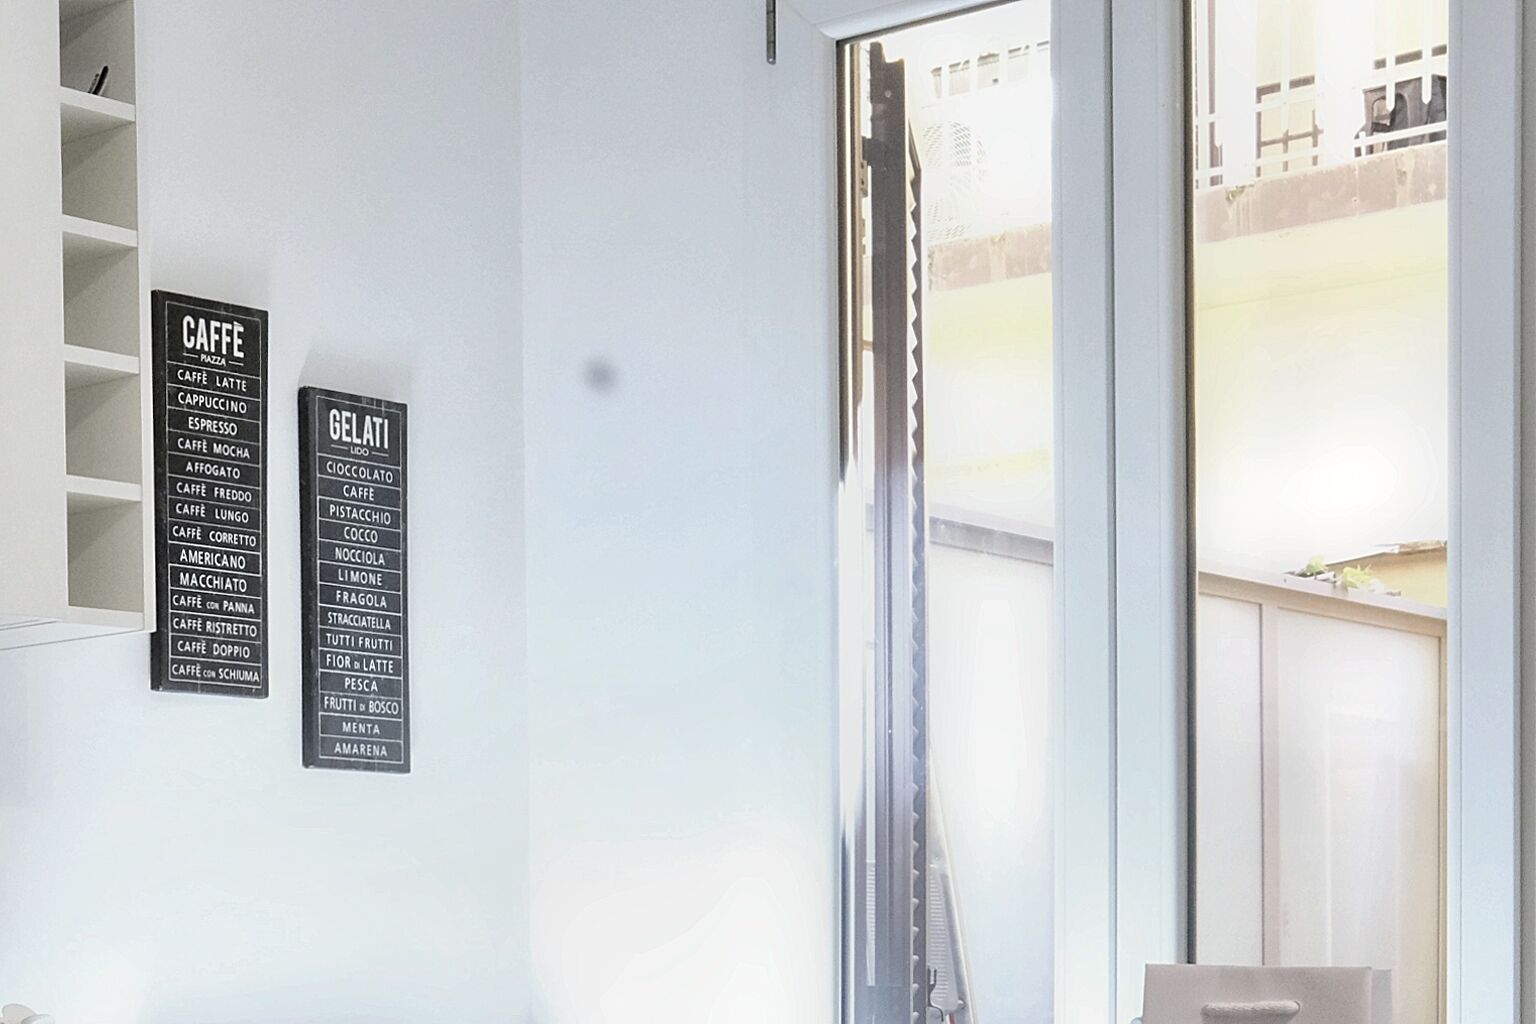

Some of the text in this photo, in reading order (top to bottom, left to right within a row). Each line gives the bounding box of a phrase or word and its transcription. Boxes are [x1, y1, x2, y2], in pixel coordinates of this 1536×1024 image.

[182, 315, 244, 358] CAFFÈ
[200, 354, 226, 366] PIAZZA
[177, 369, 247, 392] CAFFÈ LATTE
[178, 392, 247, 414] CAPPUCCINO
[188, 416, 238, 436] ESPRESSO
[329, 408, 389, 449] GELATI
[177, 437, 250, 459] CAFFÈ MOCHA
[350, 446, 369, 457] LIDO
[186, 460, 240, 479] AFFOGATO
[326, 461, 393, 484] CIOCCOLATO
[176, 482, 252, 502] CAFFÈ FREDDO
[175, 503, 249, 523] CAFFÈ LUNGO
[330, 504, 391, 525] PISTACCHIO
[172, 525, 256, 546] CAFFÈ CORRETTO
[344, 526, 378, 543] COCCO
[180, 549, 246, 569] AMERICANO
[335, 547, 385, 566] NOCCIOLA
[180, 572, 247, 592] MACCHIATO
[338, 569, 383, 586] LIMONE
[172, 594, 202, 609] CAFFÈ
[223, 600, 255, 614] PANNA
[336, 590, 387, 608] FRAGOLA
[173, 617, 257, 637] CAFFÈ RISTRETTO
[327, 612, 392, 630] STRACCIATELLA
[177, 640, 250, 658] CAFFÈ DOPPIO
[326, 633, 393, 651] TUTTI FRUTTI
[172, 663, 201, 677] CAFFÈ
[218, 670, 259, 682] SCHIUMA
[326, 654, 351, 669] FIOR
[363, 658, 394, 673] LATTE
[344, 678, 378, 692] PESCA
[324, 696, 357, 712] FRUTTI
[369, 700, 399, 715] BOSCO
[342, 722, 380, 735] MENTA
[334, 742, 388, 757] AMARENA
